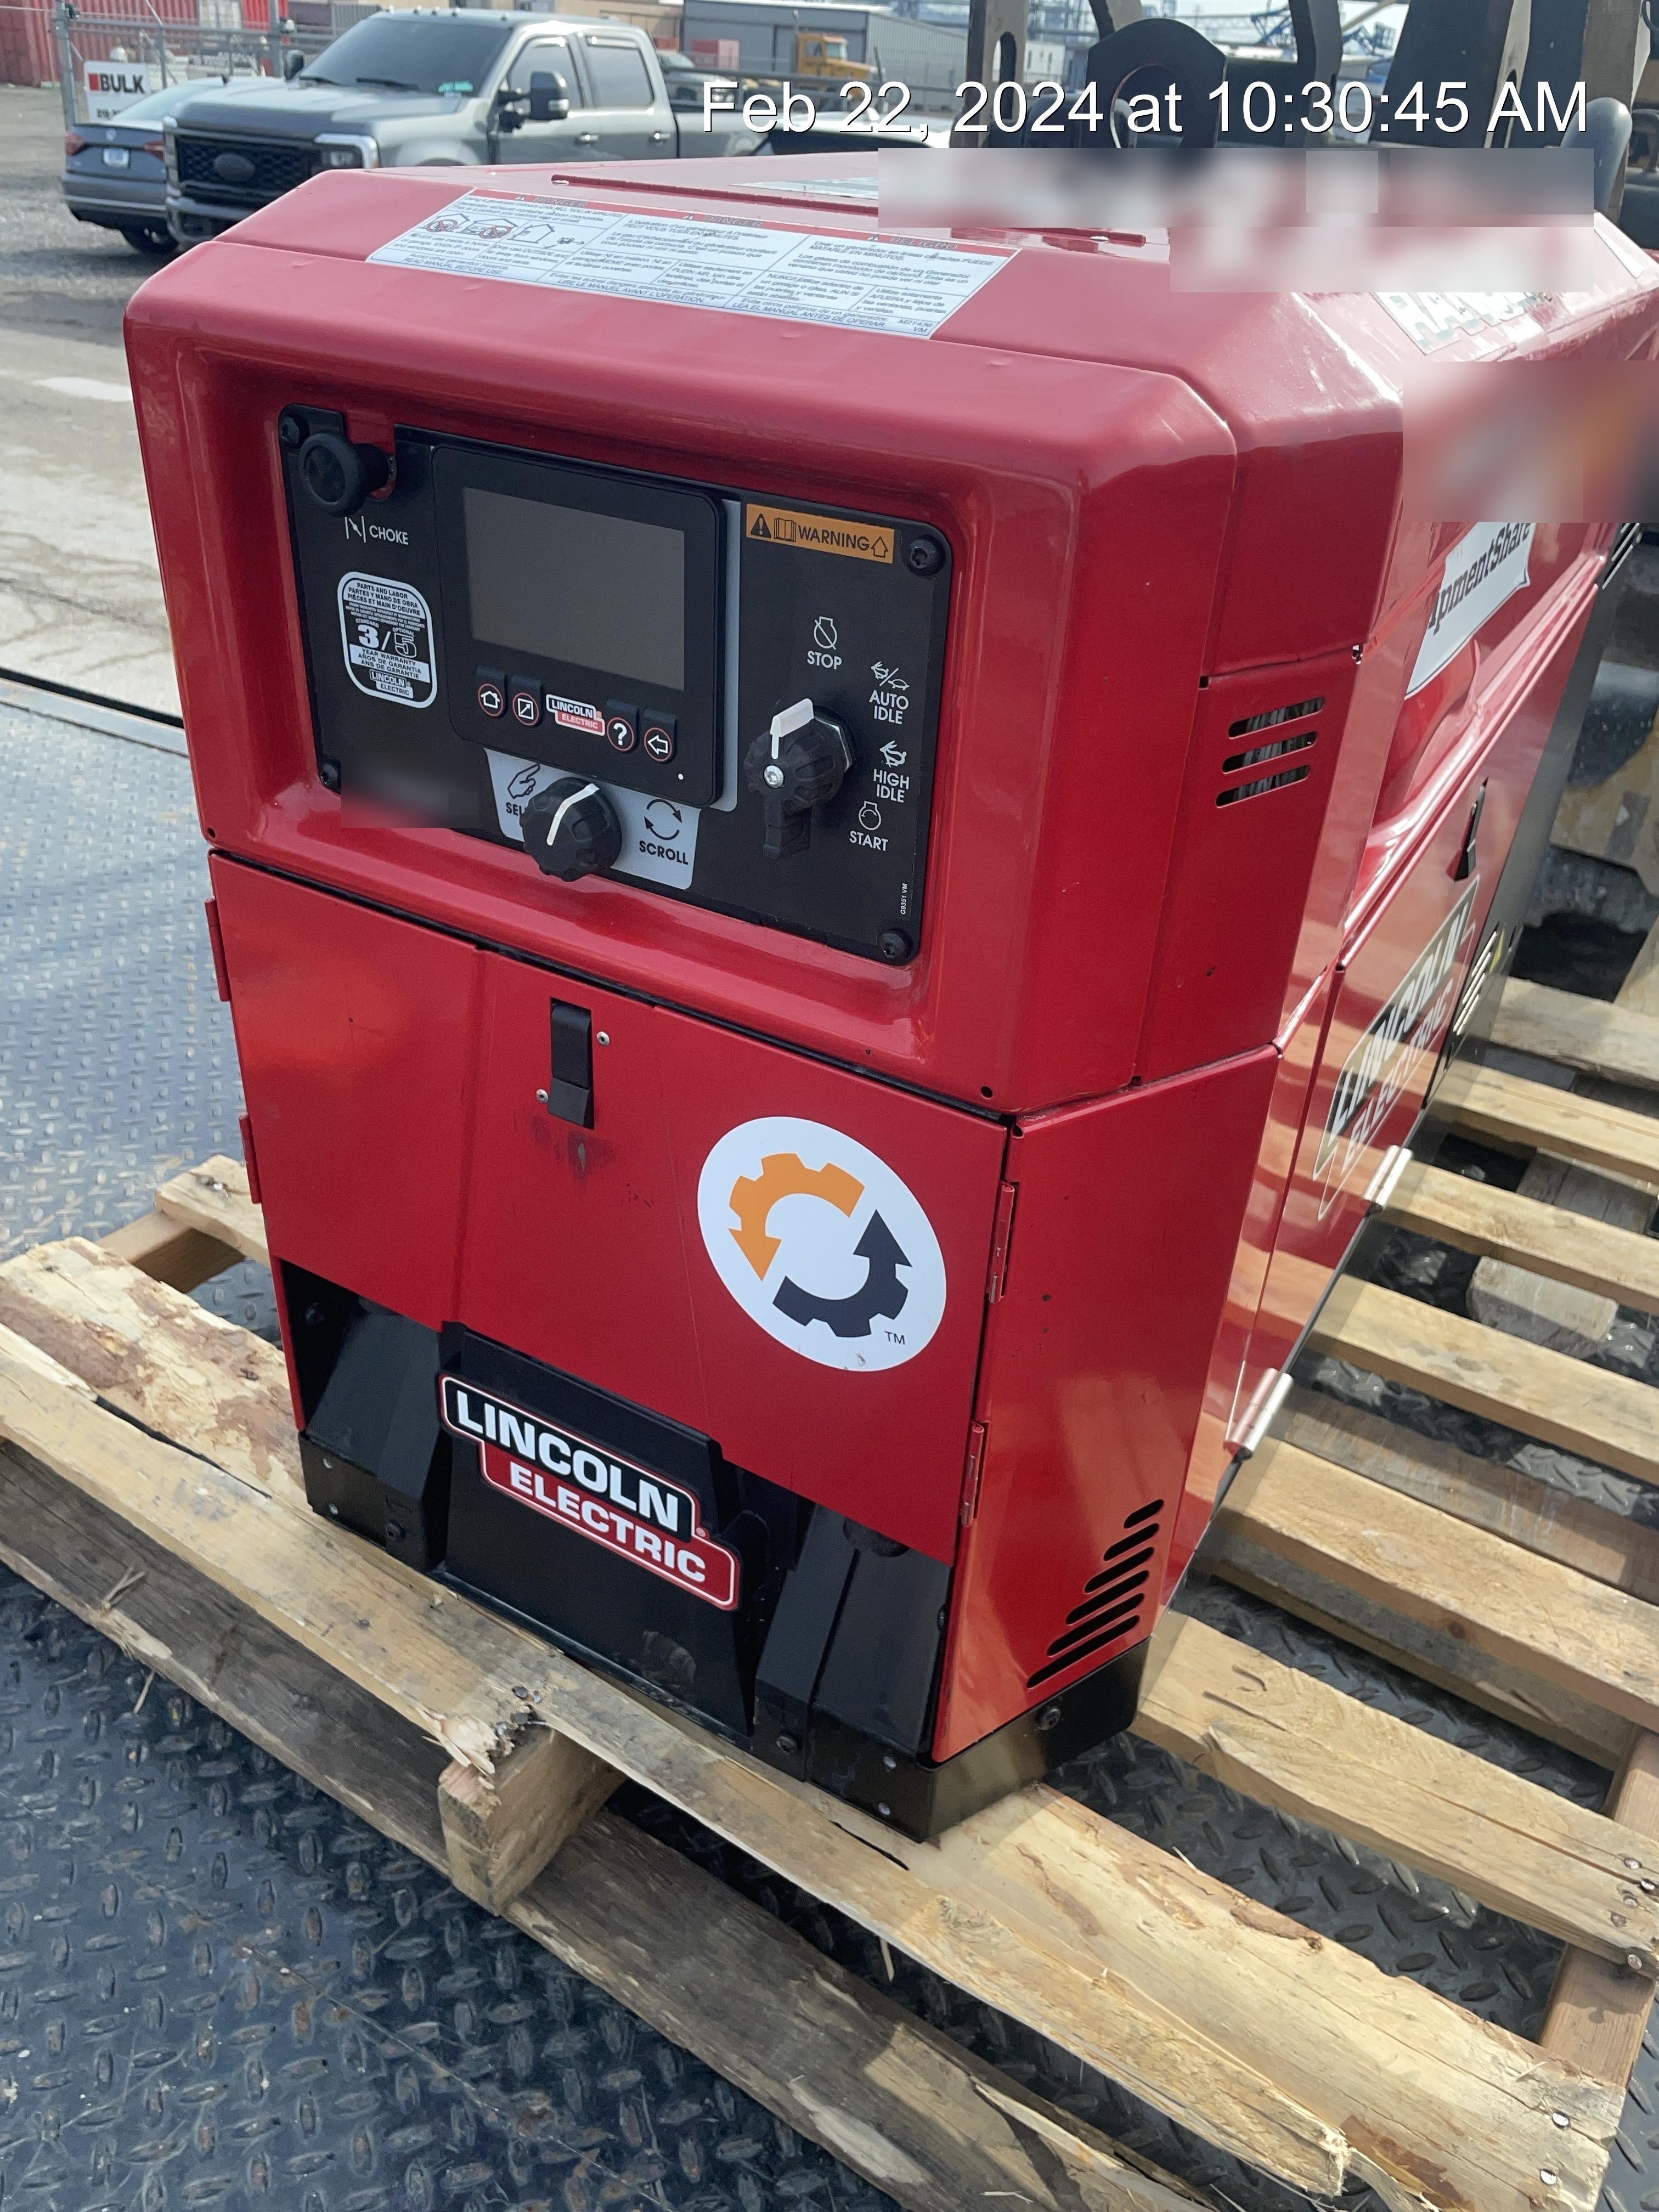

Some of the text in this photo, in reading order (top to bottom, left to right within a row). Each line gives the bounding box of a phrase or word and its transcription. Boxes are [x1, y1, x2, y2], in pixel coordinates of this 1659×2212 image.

[100, 72, 144, 93] BULK
[369, 524, 409, 545] CHOKE
[798, 524, 870, 551] WARNING
[348, 586, 369, 597] PARTES
[375, 592, 392, 602] MANO
[402, 599, 417, 608] OBRA
[357, 582, 408, 599] PARTS AND LABOR
[376, 600, 390, 608] MAIN
[356, 618, 379, 628] STANDARD
[392, 627, 415, 637] OPTIONAL
[362, 647, 416, 667] YEAR WARRANTY
[807, 651, 842, 670] STOP
[361, 658, 374, 667] ANS
[387, 665, 419, 679] GARANTIE
[388, 660, 421, 674] GARANTIA
[371, 670, 405, 687] LINCOLN
[381, 684, 409, 696] ELECTRIC
[551, 699, 592, 718] LINCOLN
[869, 690, 909, 710] AUTO
[562, 714, 598, 729] ELECTRIC
[873, 706, 902, 725] IDLE
[873, 769, 910, 789] HIGH
[877, 785, 905, 803] IDLE
[849, 830, 888, 851] START
[639, 840, 689, 865] SCROLL
[901, 883, 907, 893] VM
[1327, 901, 1469, 1150] LINCOLN
[1341, 978, 1454, 1176] ELECTRIC
[884, 1330, 905, 1345] TM
[456, 1390, 678, 1532] LINCOLN
[510, 1462, 706, 1583] ELECTRIC
